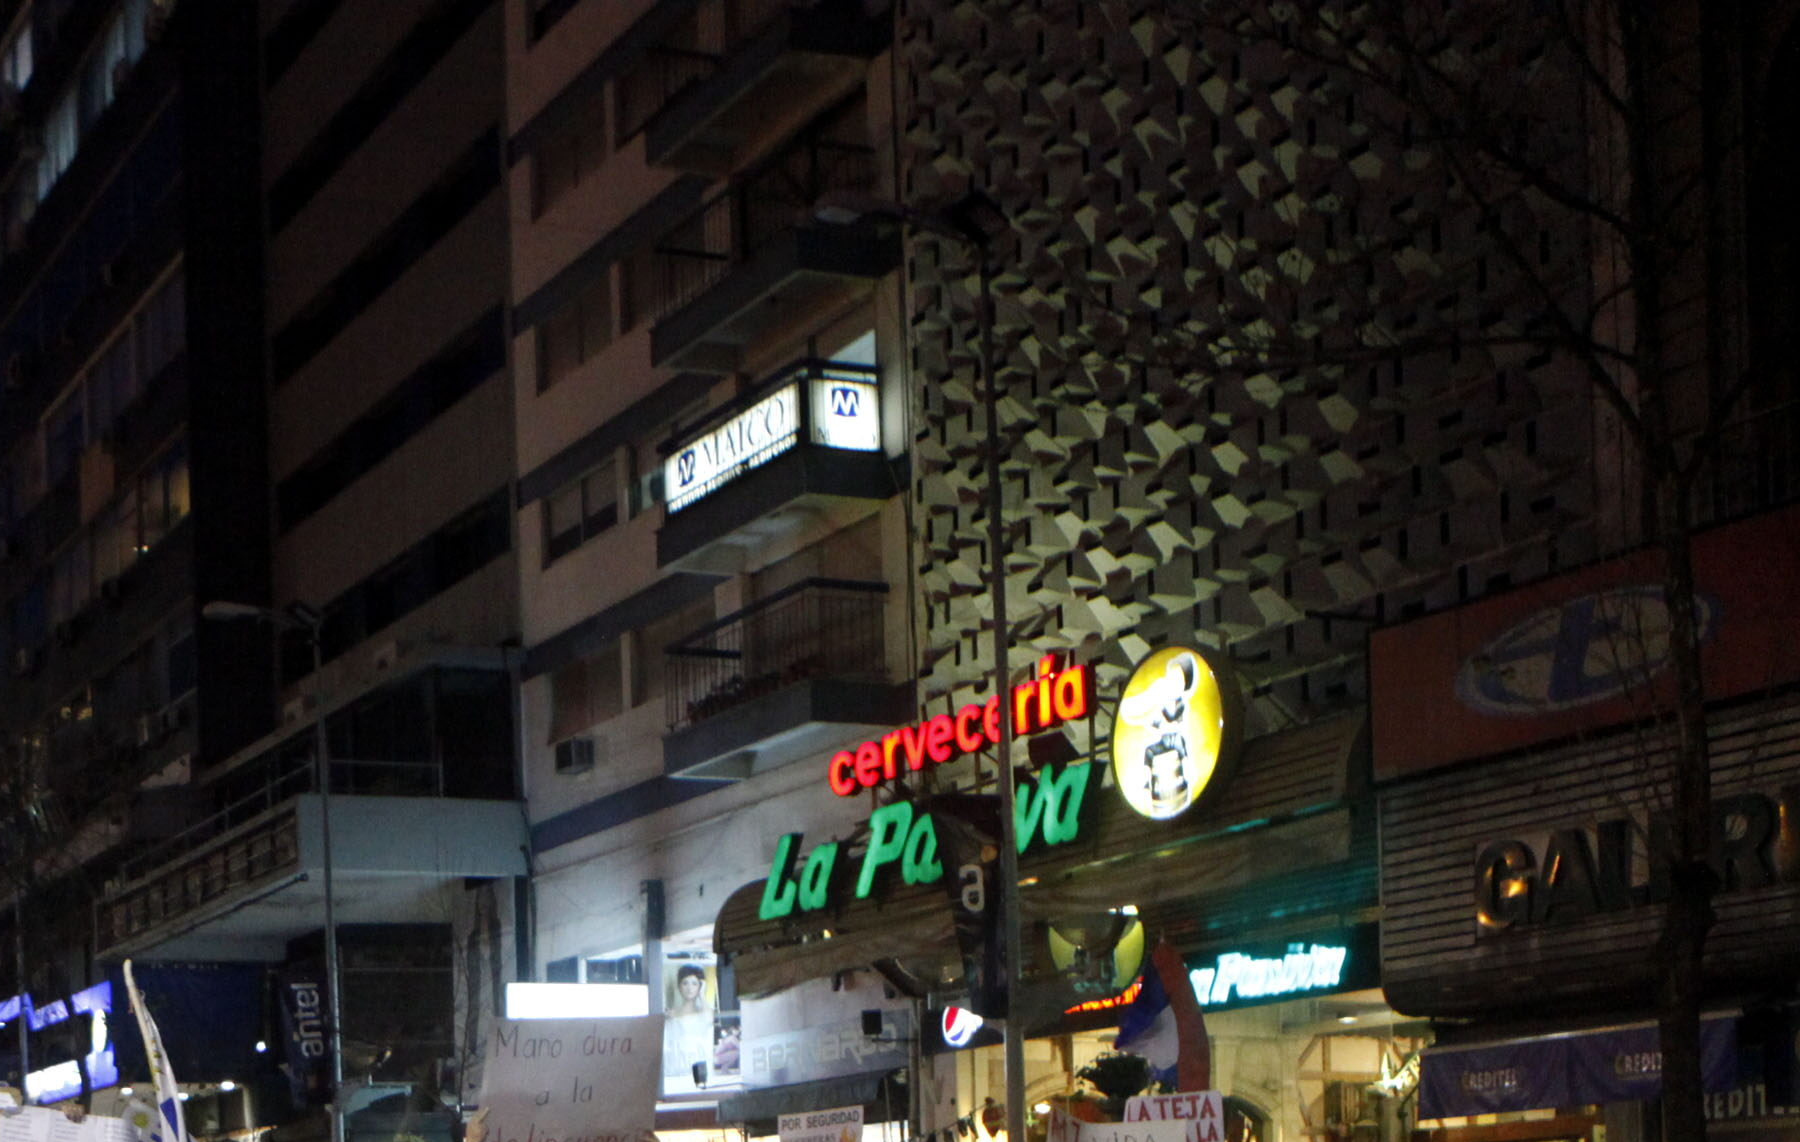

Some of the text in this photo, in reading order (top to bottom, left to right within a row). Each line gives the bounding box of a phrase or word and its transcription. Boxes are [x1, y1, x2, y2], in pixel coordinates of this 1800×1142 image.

[758, 834, 840, 921] La
[289, 982, 324, 1059] antel
[495, 1023, 633, 1059] Mano dura
[535, 1075, 593, 1106] a la
[781, 1110, 860, 1131] POR SEGURIDAD
[1127, 1094, 1216, 1123] LA TEJA
[1196, 1121, 1219, 1142] LA
